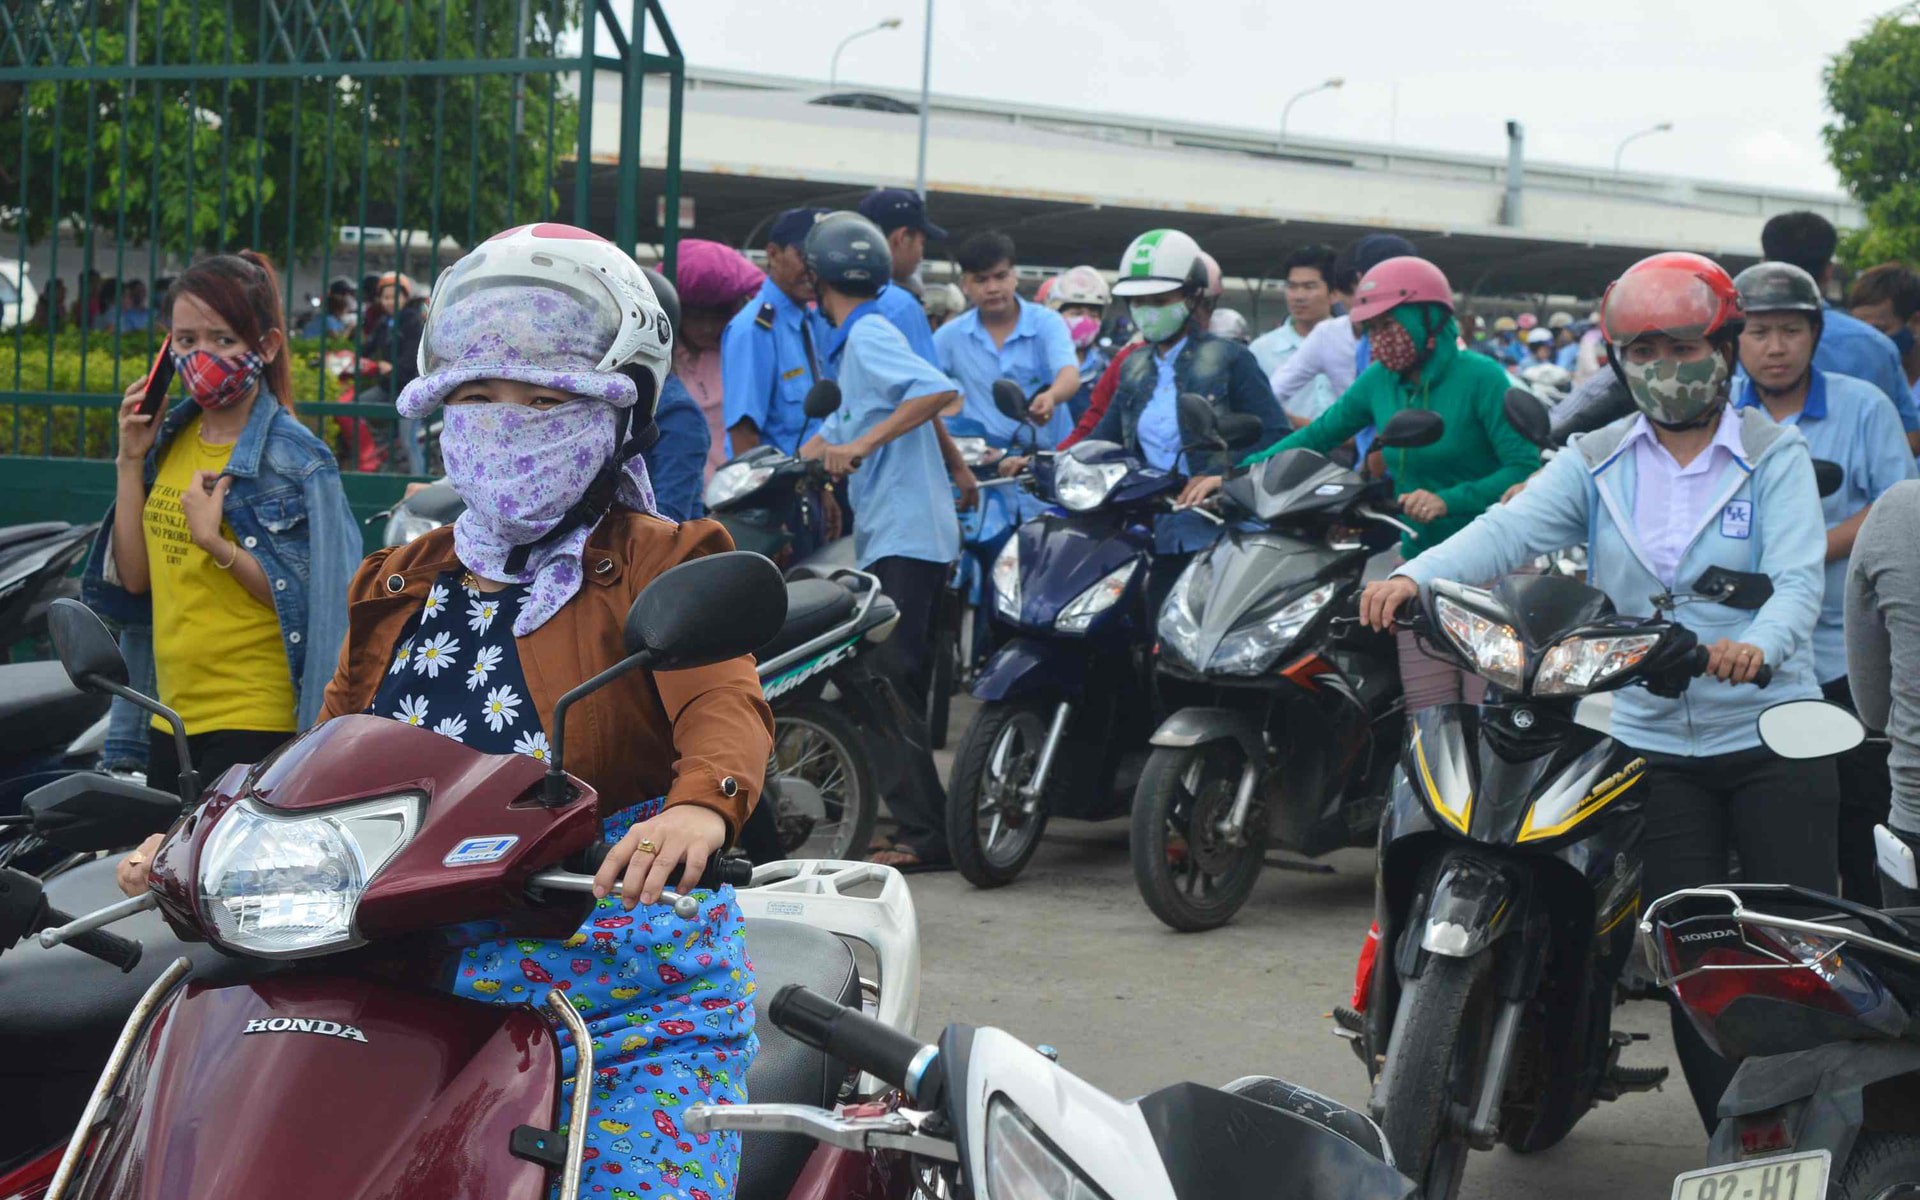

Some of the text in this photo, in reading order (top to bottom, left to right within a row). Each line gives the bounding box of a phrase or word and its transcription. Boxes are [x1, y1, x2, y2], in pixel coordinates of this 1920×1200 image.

[457, 839, 511, 855] FI
[1678, 929, 1739, 943] HONDA
[242, 1018, 369, 1043] HONDA
